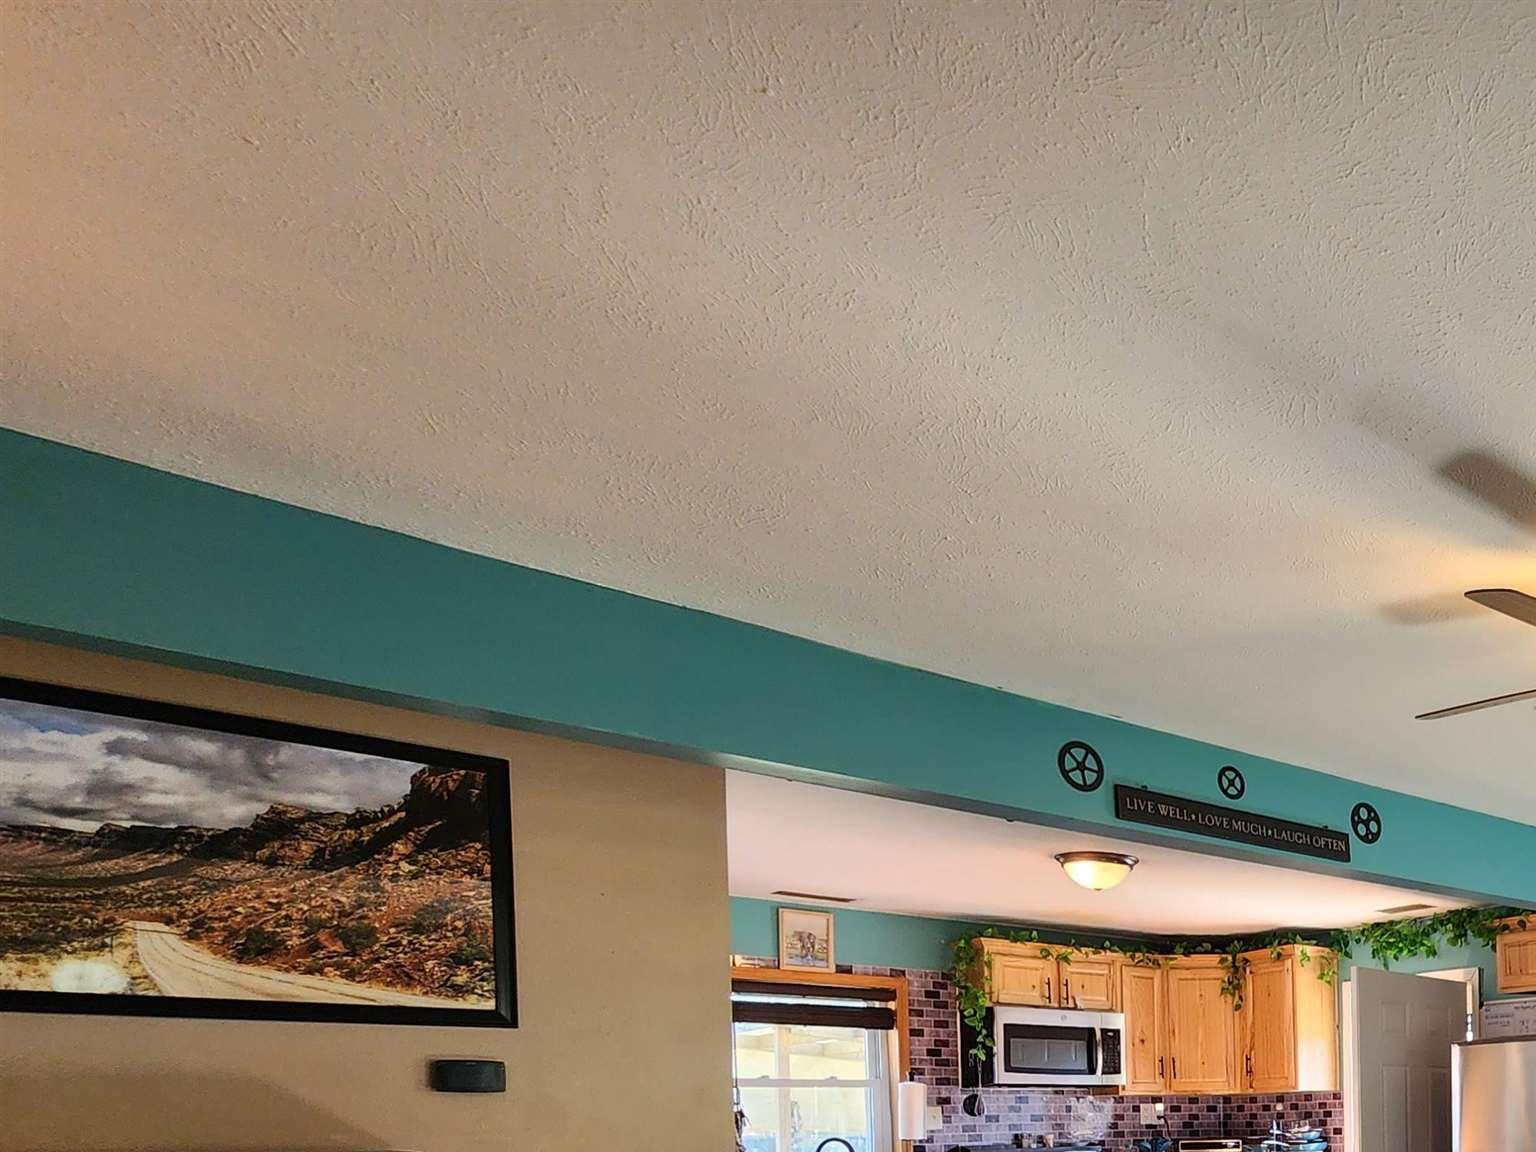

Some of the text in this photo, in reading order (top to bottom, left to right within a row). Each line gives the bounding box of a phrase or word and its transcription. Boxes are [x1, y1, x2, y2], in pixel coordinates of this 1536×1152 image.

[1126, 797, 1347, 852] LIVE WELL LOVE MUCH LAUGH OFTEN
